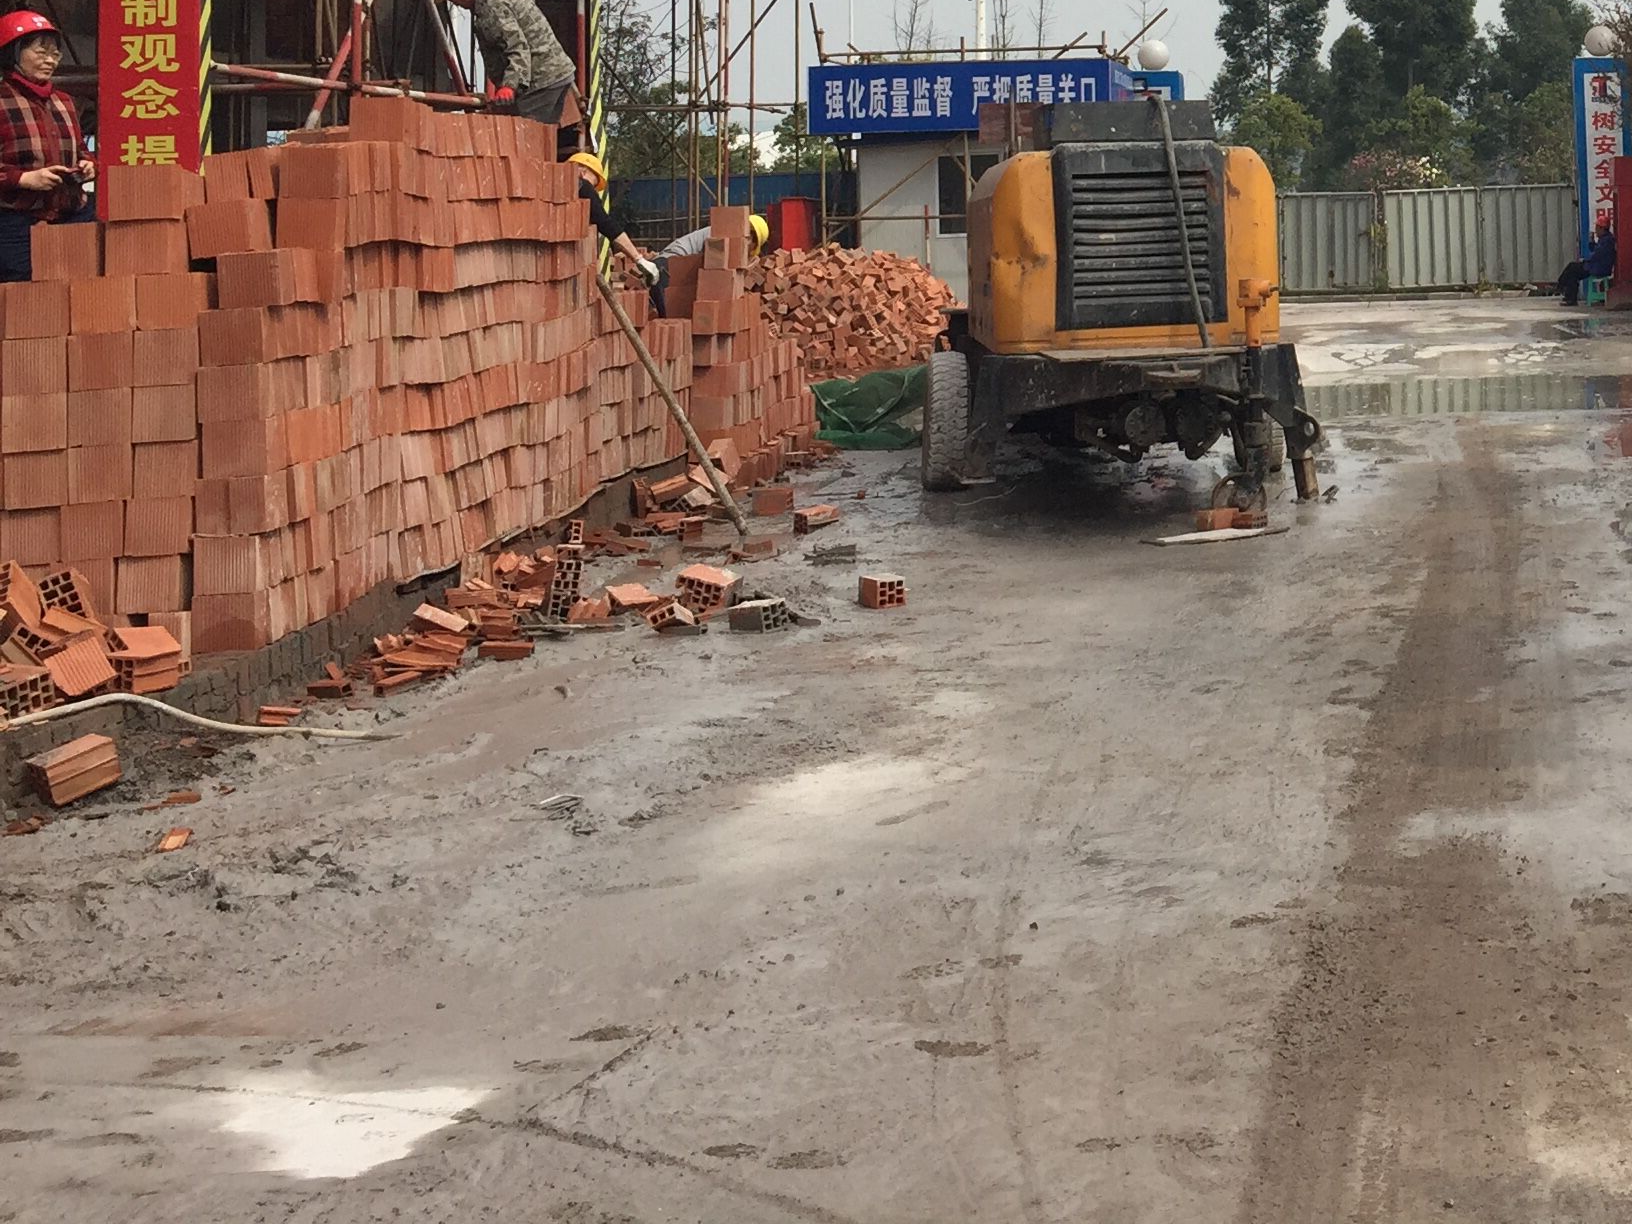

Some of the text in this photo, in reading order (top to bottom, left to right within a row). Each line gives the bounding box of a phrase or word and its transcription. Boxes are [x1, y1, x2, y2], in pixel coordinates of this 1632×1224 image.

[825, 76, 953, 119] 强化质量监督
